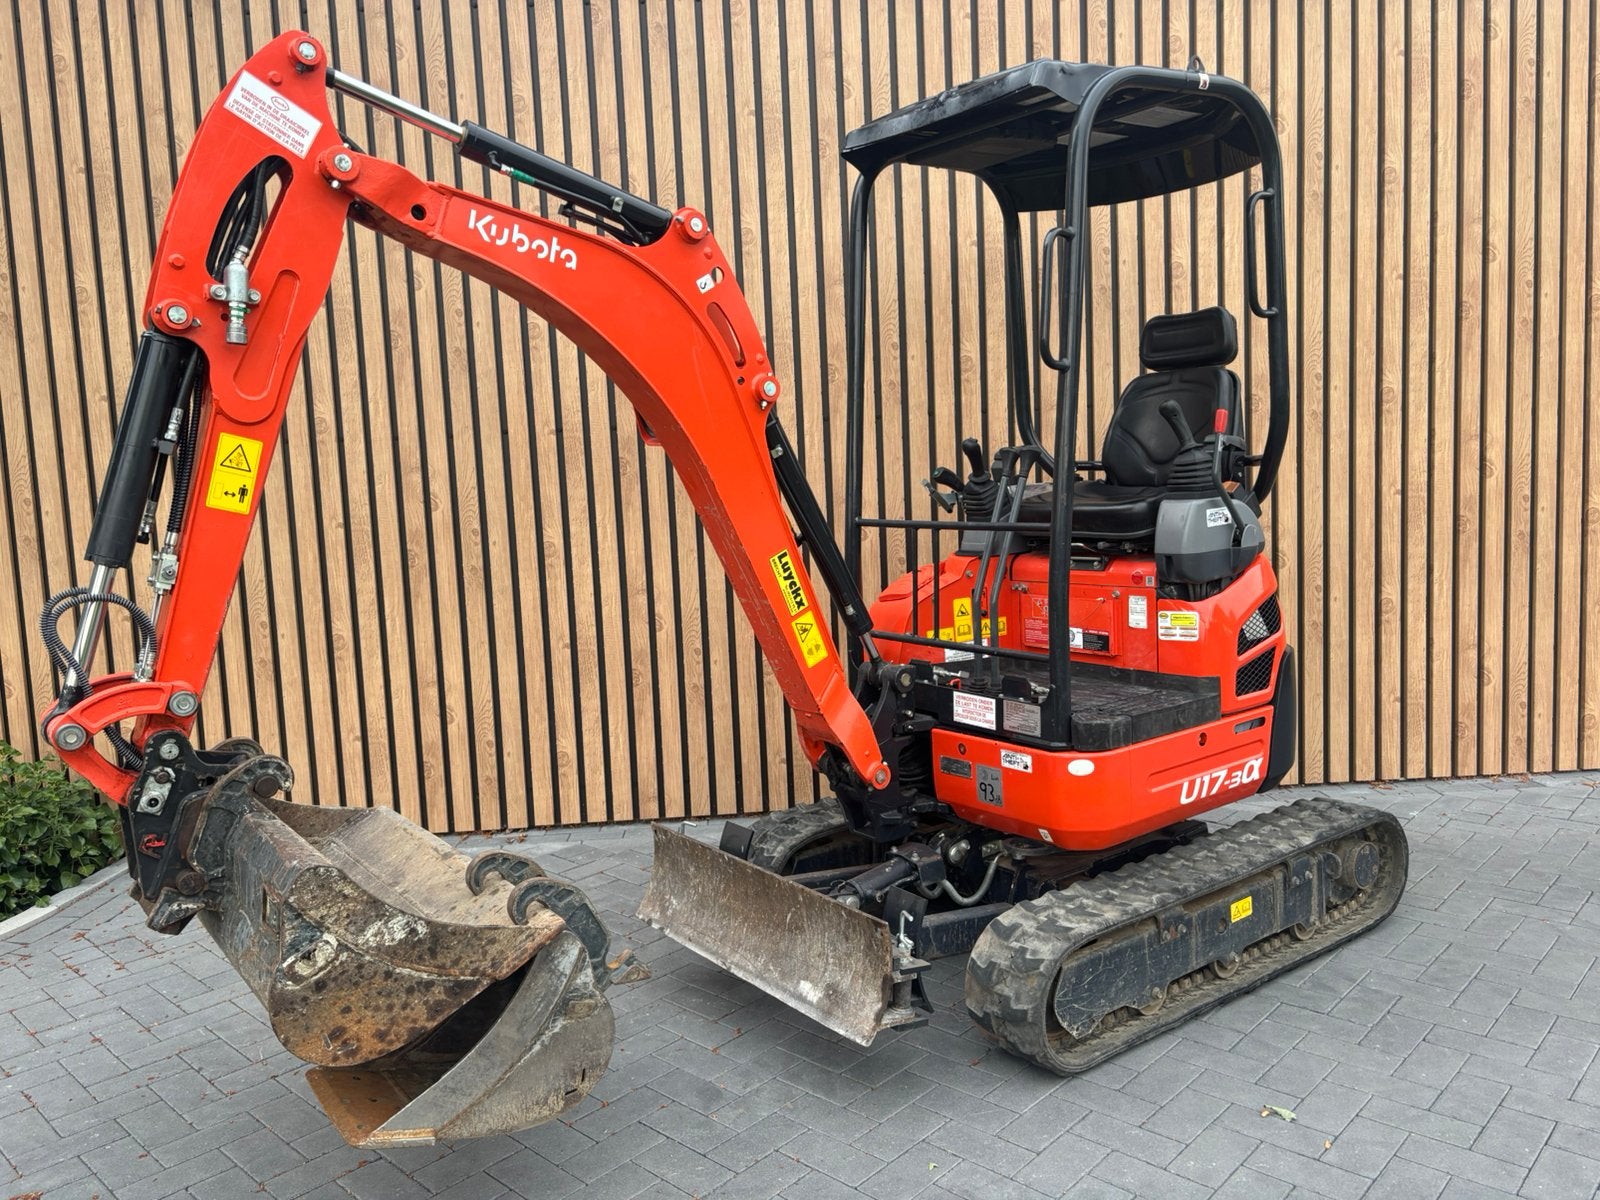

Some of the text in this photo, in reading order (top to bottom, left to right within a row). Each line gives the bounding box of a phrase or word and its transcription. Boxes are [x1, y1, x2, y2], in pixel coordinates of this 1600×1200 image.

[239, 87, 266, 106] VERBODEN
[240, 93, 252, 103] VAN
[258, 105, 280, 122] MACHINE
[287, 124, 305, 138] KOMEN
[234, 106, 251, 120] RAYON
[288, 142, 303, 154] PELLE
[261, 117, 291, 139] STATIONNER
[290, 137, 304, 148] DANS
[468, 209, 577, 270] Kubota
[777, 551, 806, 611] Luyckx
[980, 782, 994, 801] 93
